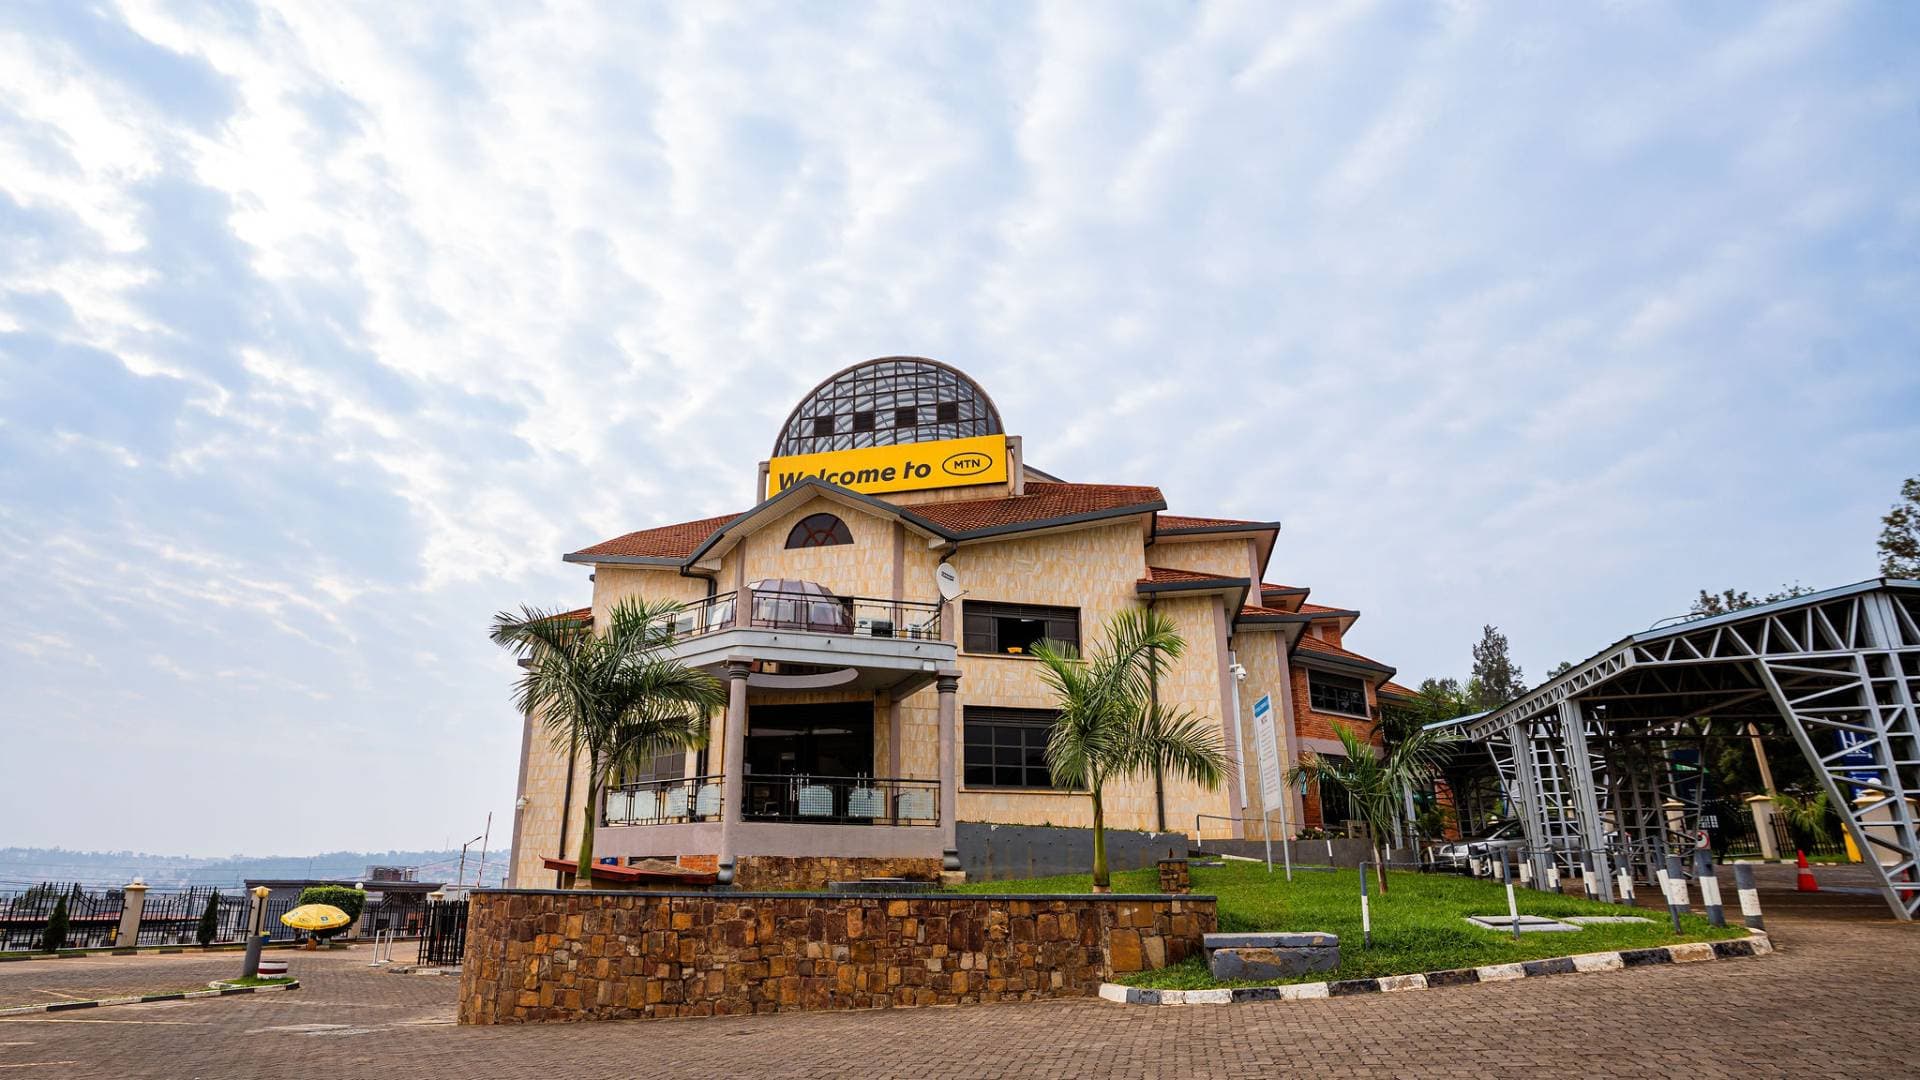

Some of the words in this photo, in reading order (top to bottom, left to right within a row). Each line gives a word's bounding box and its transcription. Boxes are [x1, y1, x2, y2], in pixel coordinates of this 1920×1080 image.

[779, 466, 896, 490] Wlcome
[903, 461, 931, 479] to
[954, 459, 981, 469] MTN
